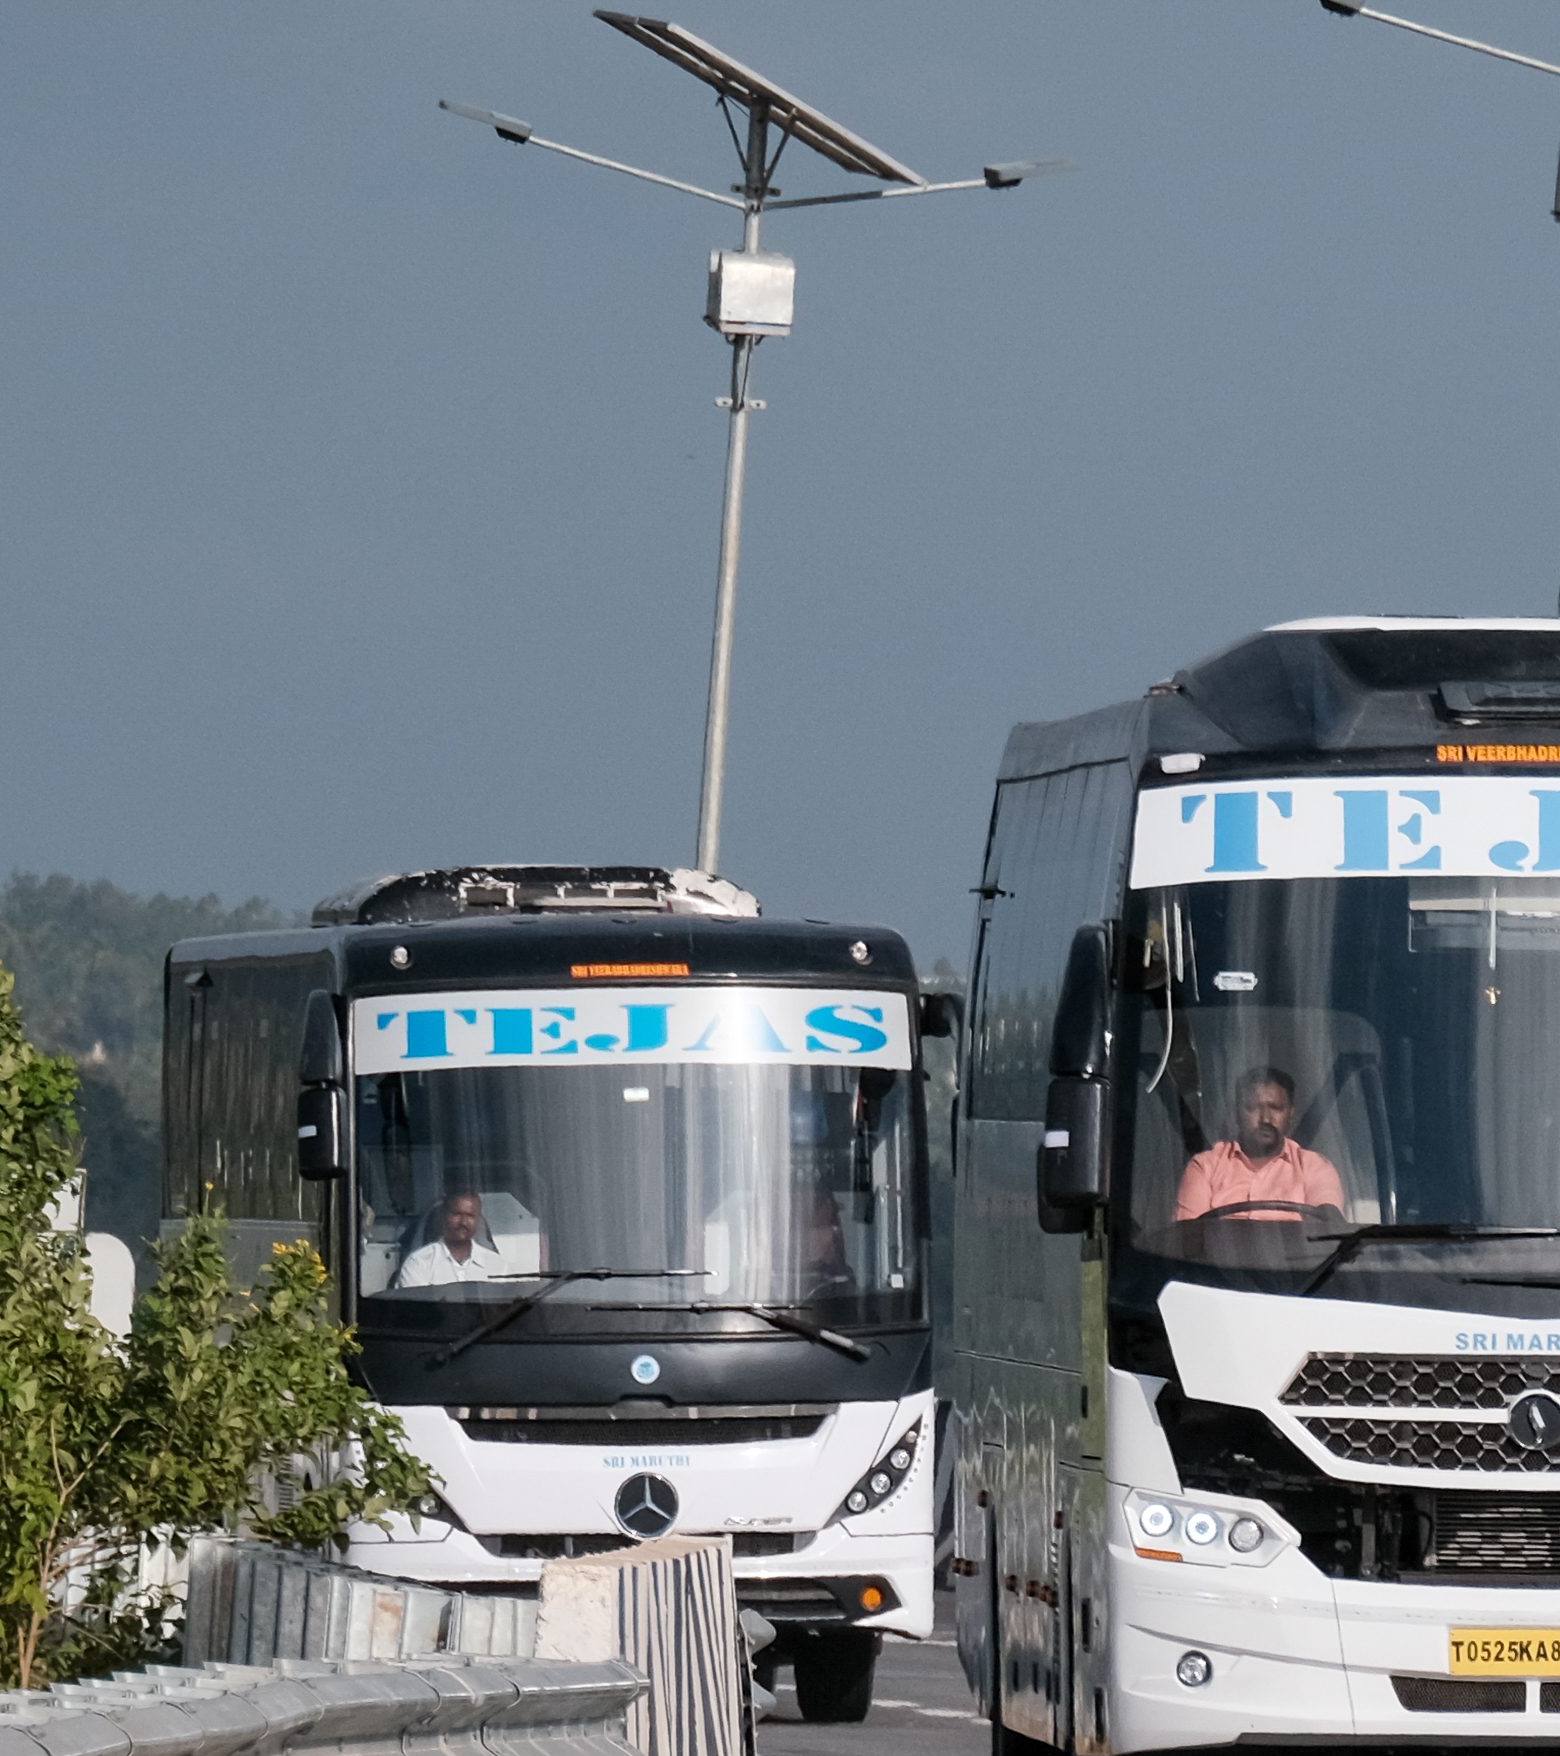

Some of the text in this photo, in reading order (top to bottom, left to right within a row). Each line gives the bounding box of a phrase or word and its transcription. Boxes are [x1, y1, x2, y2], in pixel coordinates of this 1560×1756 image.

[1437, 745, 1463, 762] SRI
[377, 1004, 888, 1059] TEJAS
[1456, 1333, 1497, 1350] SRI
